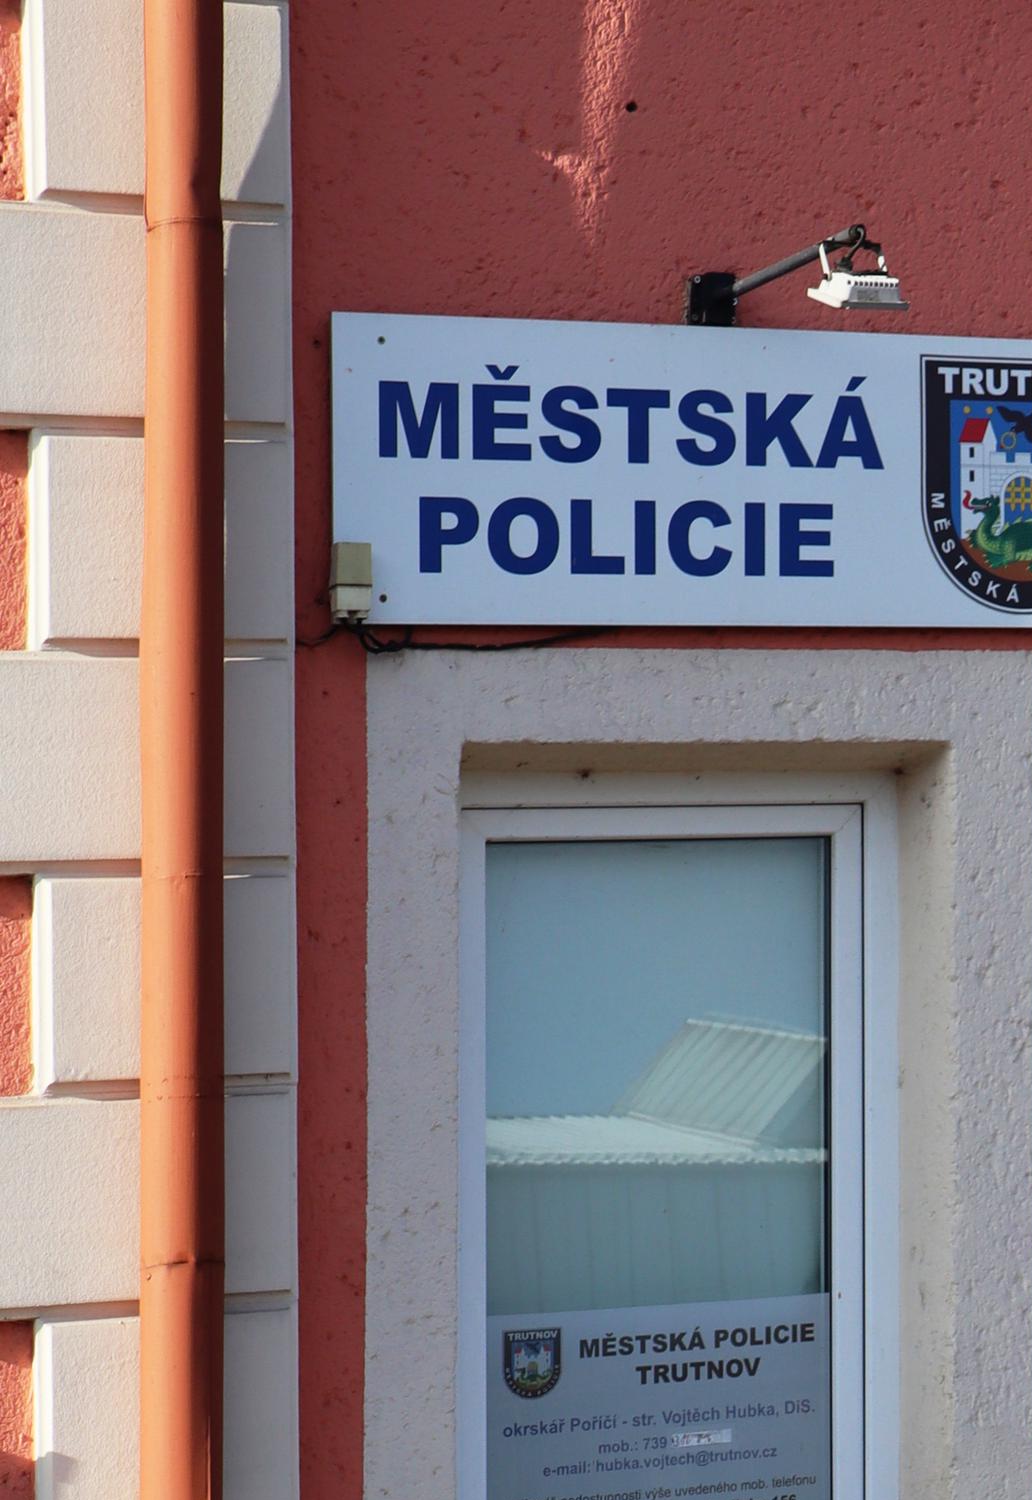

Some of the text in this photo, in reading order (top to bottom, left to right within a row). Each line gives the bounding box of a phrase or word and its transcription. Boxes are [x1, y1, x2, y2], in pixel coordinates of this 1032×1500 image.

[378, 364, 885, 471] MĚSTSKÁ
[419, 497, 835, 578] POLICIE
[931, 492, 1019, 603] MĚSTSKÁ
[507, 1329, 558, 1342] TRUTNOV
[579, 1323, 816, 1359] MĚSTSKÁ POLICIE
[636, 1357, 761, 1385] TRUTNOV
[503, 1419, 565, 1438] okrskář
[570, 1414, 617, 1432] Poříčí
[632, 1415, 657, 1427] str.
[662, 1406, 721, 1426] Vojtěch
[726, 1403, 779, 1419] Hubka,
[784, 1399, 816, 1415] DiS.
[598, 1440, 639, 1454] mob.:
[642, 1436, 668, 1451] 739
[543, 1460, 591, 1477] e-mail:
[645, 1485, 672, 1500] výše
[675, 1479, 738, 1496] uvedeného
[741, 1478, 768, 1491] mob.
[772, 1474, 817, 1488] telefonu
